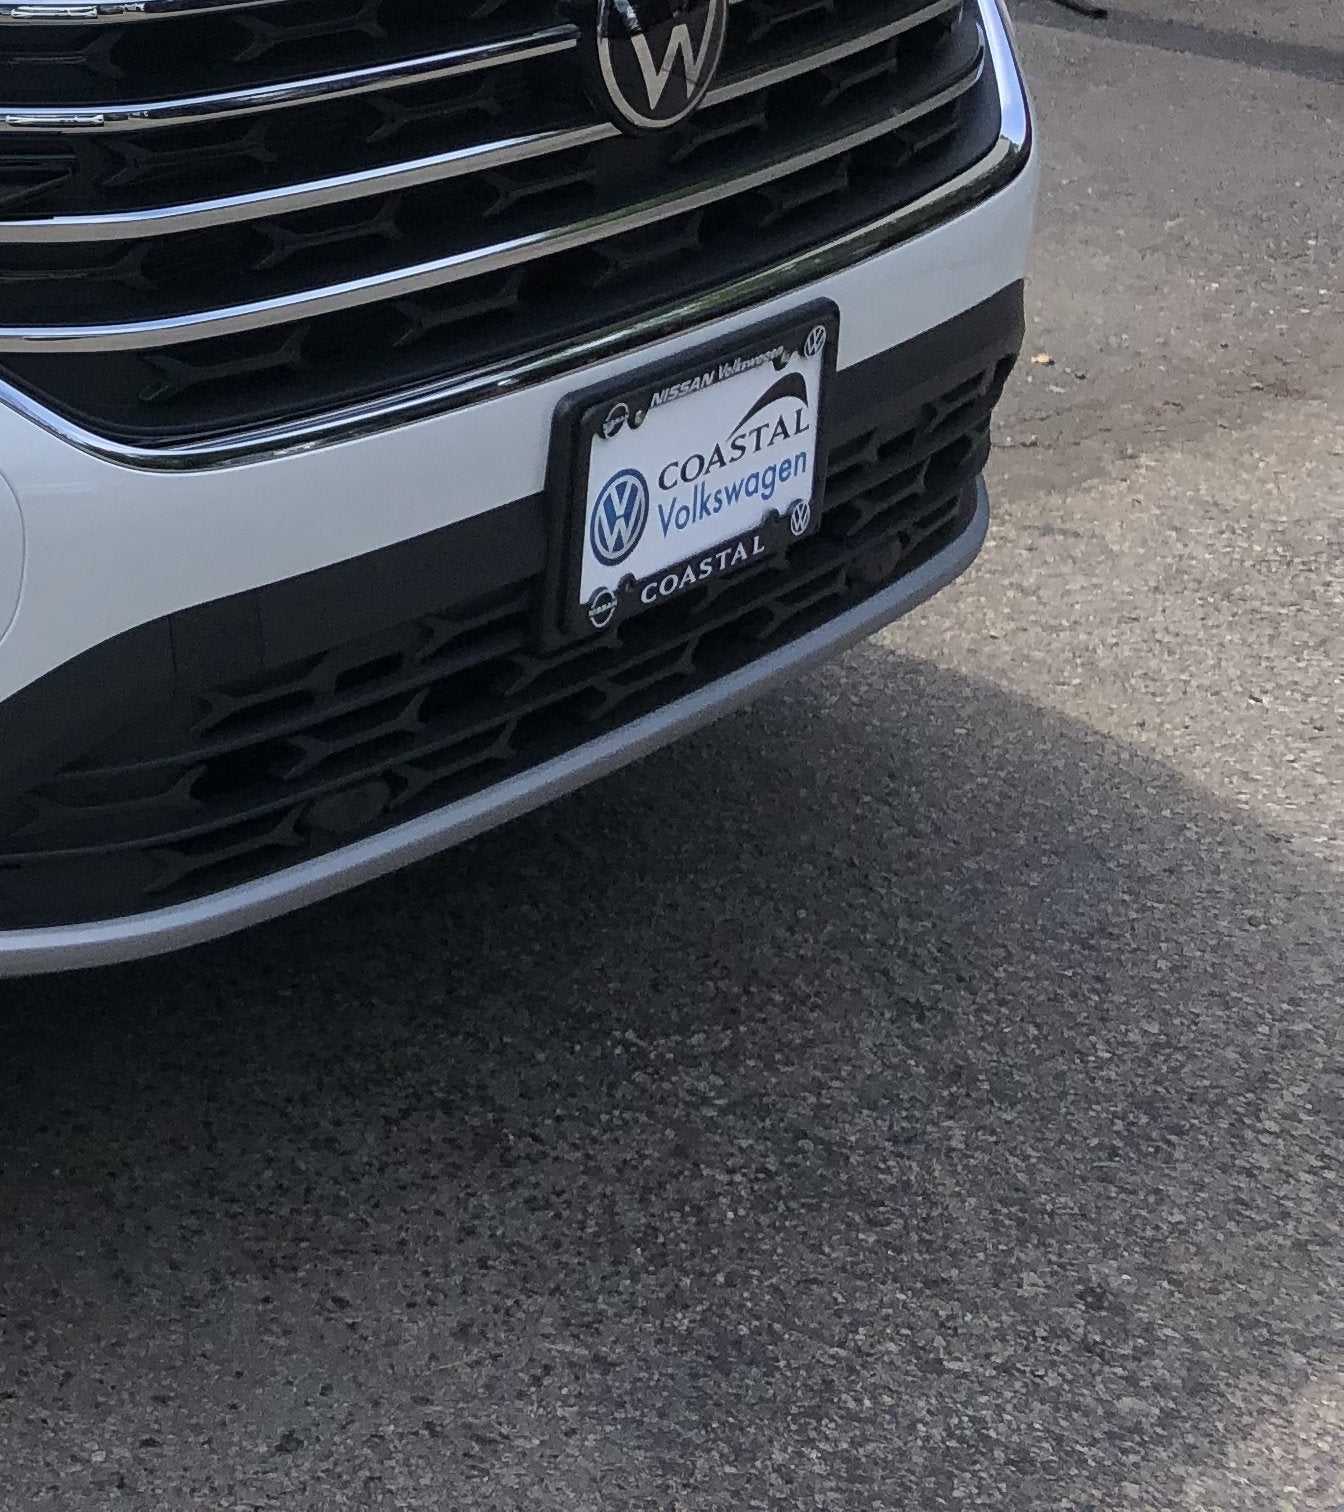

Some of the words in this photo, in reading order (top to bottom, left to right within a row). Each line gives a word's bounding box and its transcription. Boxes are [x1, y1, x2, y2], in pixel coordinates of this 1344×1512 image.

[650, 371, 715, 408] NISSAN
[657, 408, 810, 491] COASTAL
[657, 450, 807, 538] Volkswagen
[640, 535, 765, 604] COASTAL
